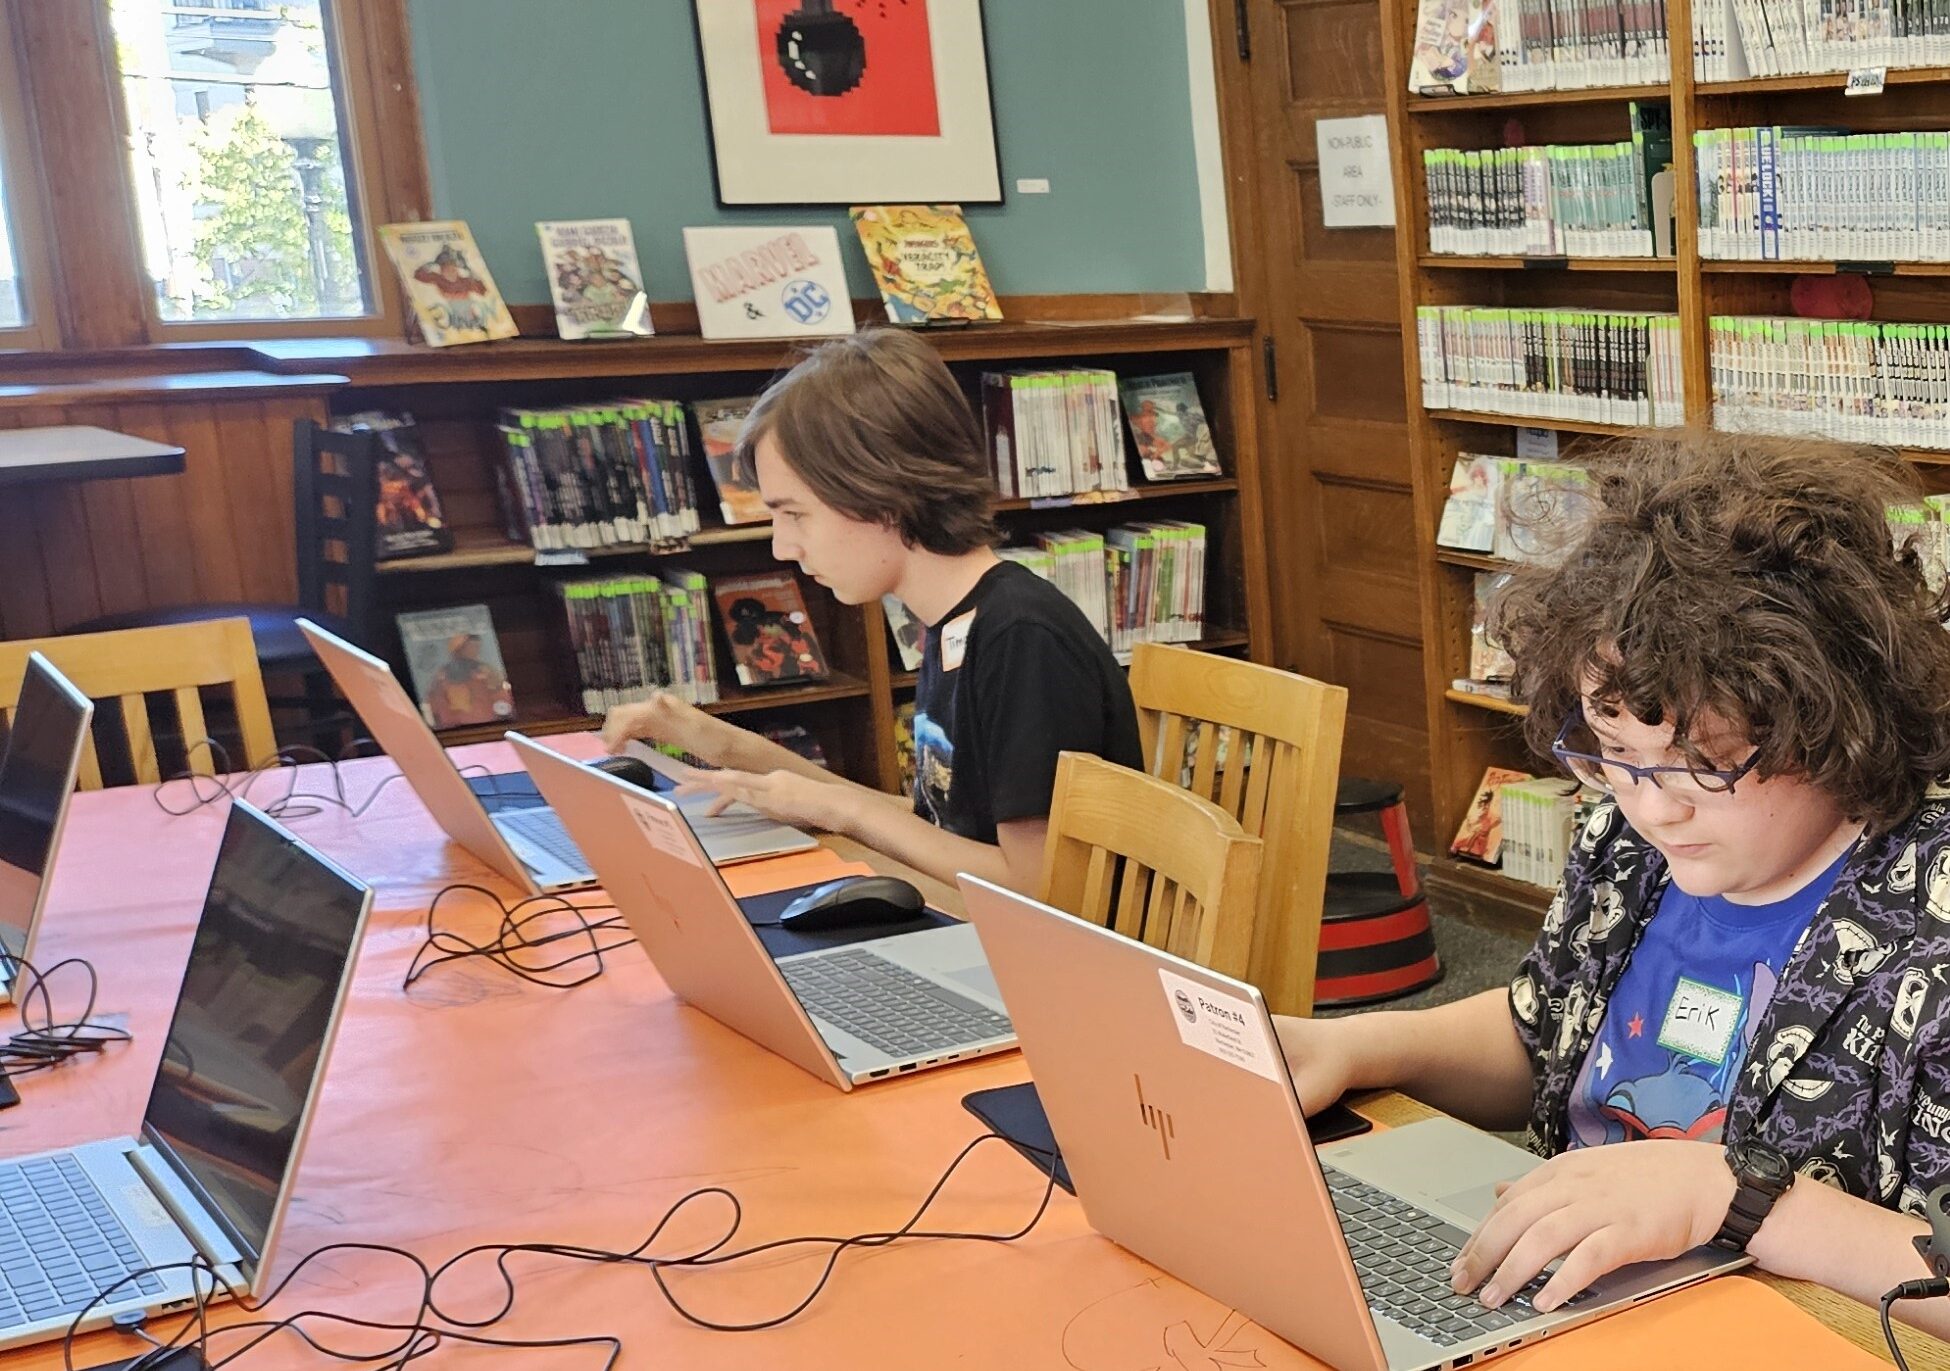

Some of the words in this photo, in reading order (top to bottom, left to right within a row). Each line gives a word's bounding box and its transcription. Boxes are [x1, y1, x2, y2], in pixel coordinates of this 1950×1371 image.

[1327, 135, 1374, 150] NON-PUBLIC
[1343, 165, 1364, 178] AREA
[699, 232, 821, 304] MARVEL
[783, 280, 830, 322] DC
[1198, 996, 1232, 1021] Patron
[1232, 1011, 1246, 1026] #4
